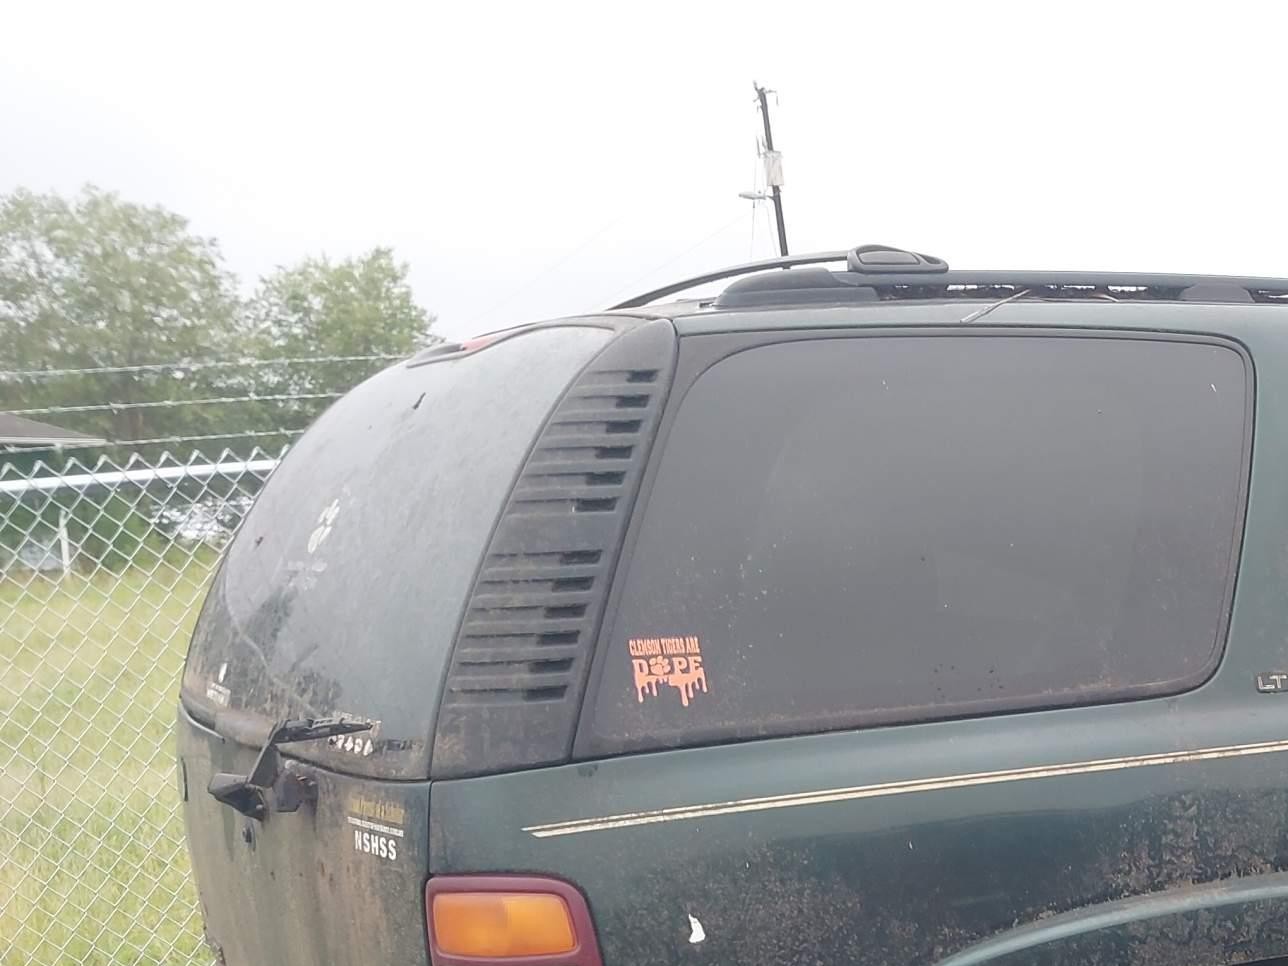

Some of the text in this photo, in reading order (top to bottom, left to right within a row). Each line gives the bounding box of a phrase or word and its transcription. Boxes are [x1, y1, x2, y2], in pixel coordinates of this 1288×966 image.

[628, 636, 700, 656] CLEMSON TIGERS ARE
[1257, 674, 1288, 690] LT
[354, 829, 398, 861] NSHSS
